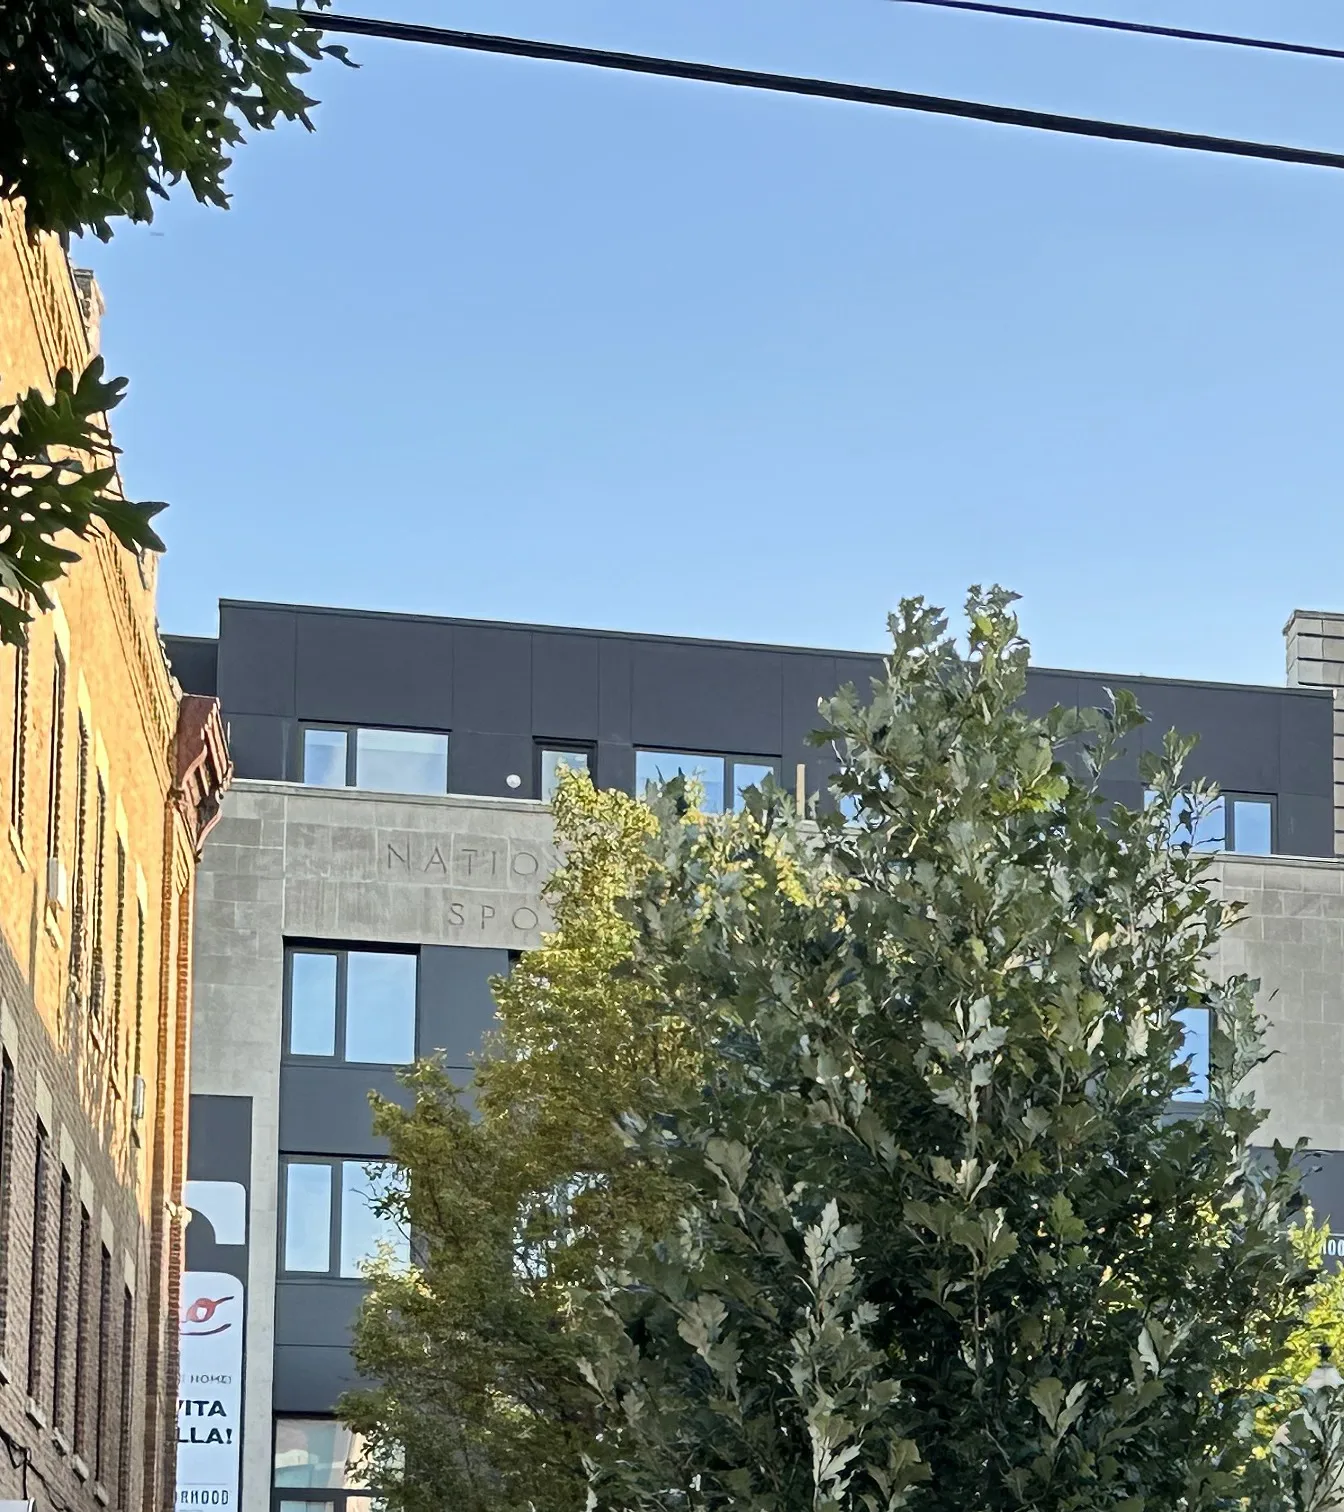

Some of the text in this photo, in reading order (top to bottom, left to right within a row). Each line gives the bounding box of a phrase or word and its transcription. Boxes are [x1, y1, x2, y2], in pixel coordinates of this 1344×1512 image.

[387, 841, 565, 877] NATIO
[448, 902, 539, 931] SPO
[177, 1427, 233, 1445] LLA!
[175, 1489, 229, 1505] RHOOD
